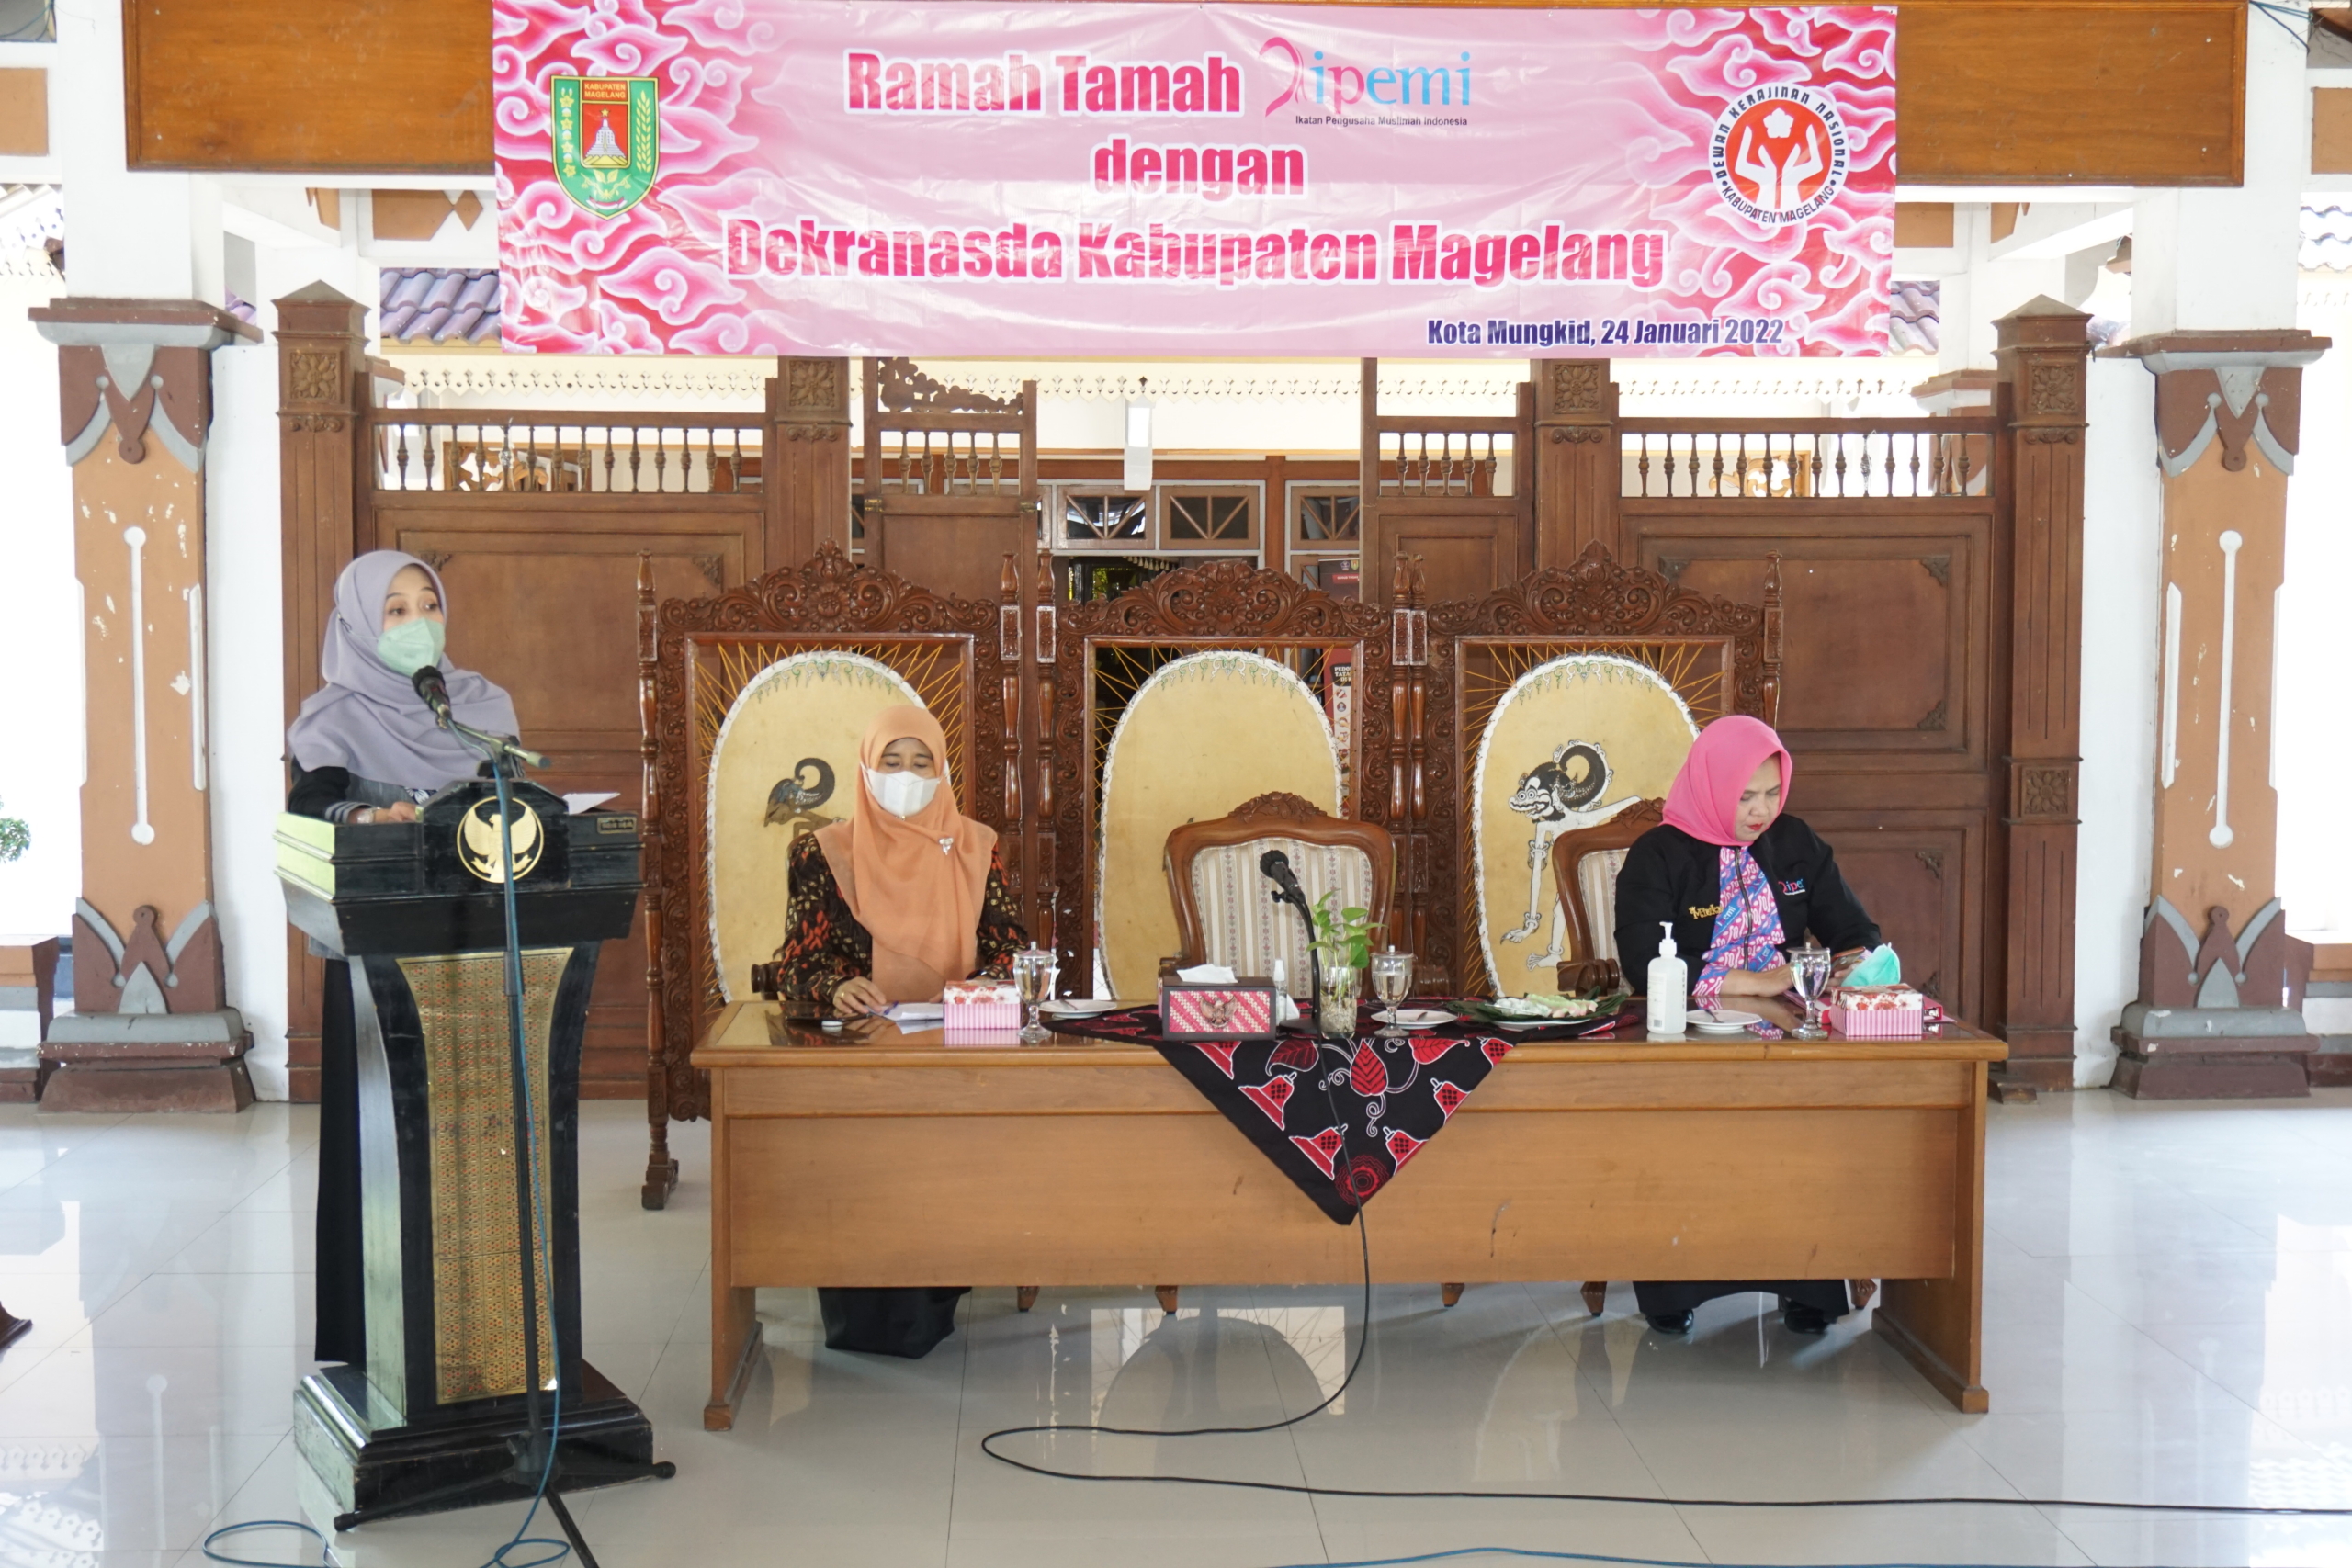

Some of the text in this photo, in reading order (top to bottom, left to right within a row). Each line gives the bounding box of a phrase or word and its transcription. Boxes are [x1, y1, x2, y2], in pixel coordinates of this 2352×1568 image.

[584, 83, 626, 91] KABUPATEN
[584, 90, 626, 98] MAGELANG
[848, 52, 1240, 112] Ramah Tamah
[1309, 51, 1471, 115] ipemi
[1295, 116, 1468, 128] Ikatan Pengusaha Muslimah Indonesia
[1713, 85, 1846, 179] DEWAN KERAJINAN NASIONAL
[1094, 138, 1304, 201] dengan
[1722, 186, 1835, 223] KABUPATEN MAGELANG
[728, 219, 1664, 288] Dekranasda Kabupaten Magelang
[1428, 319, 1784, 347] Kota Mungkid, 24 Januari 2022
